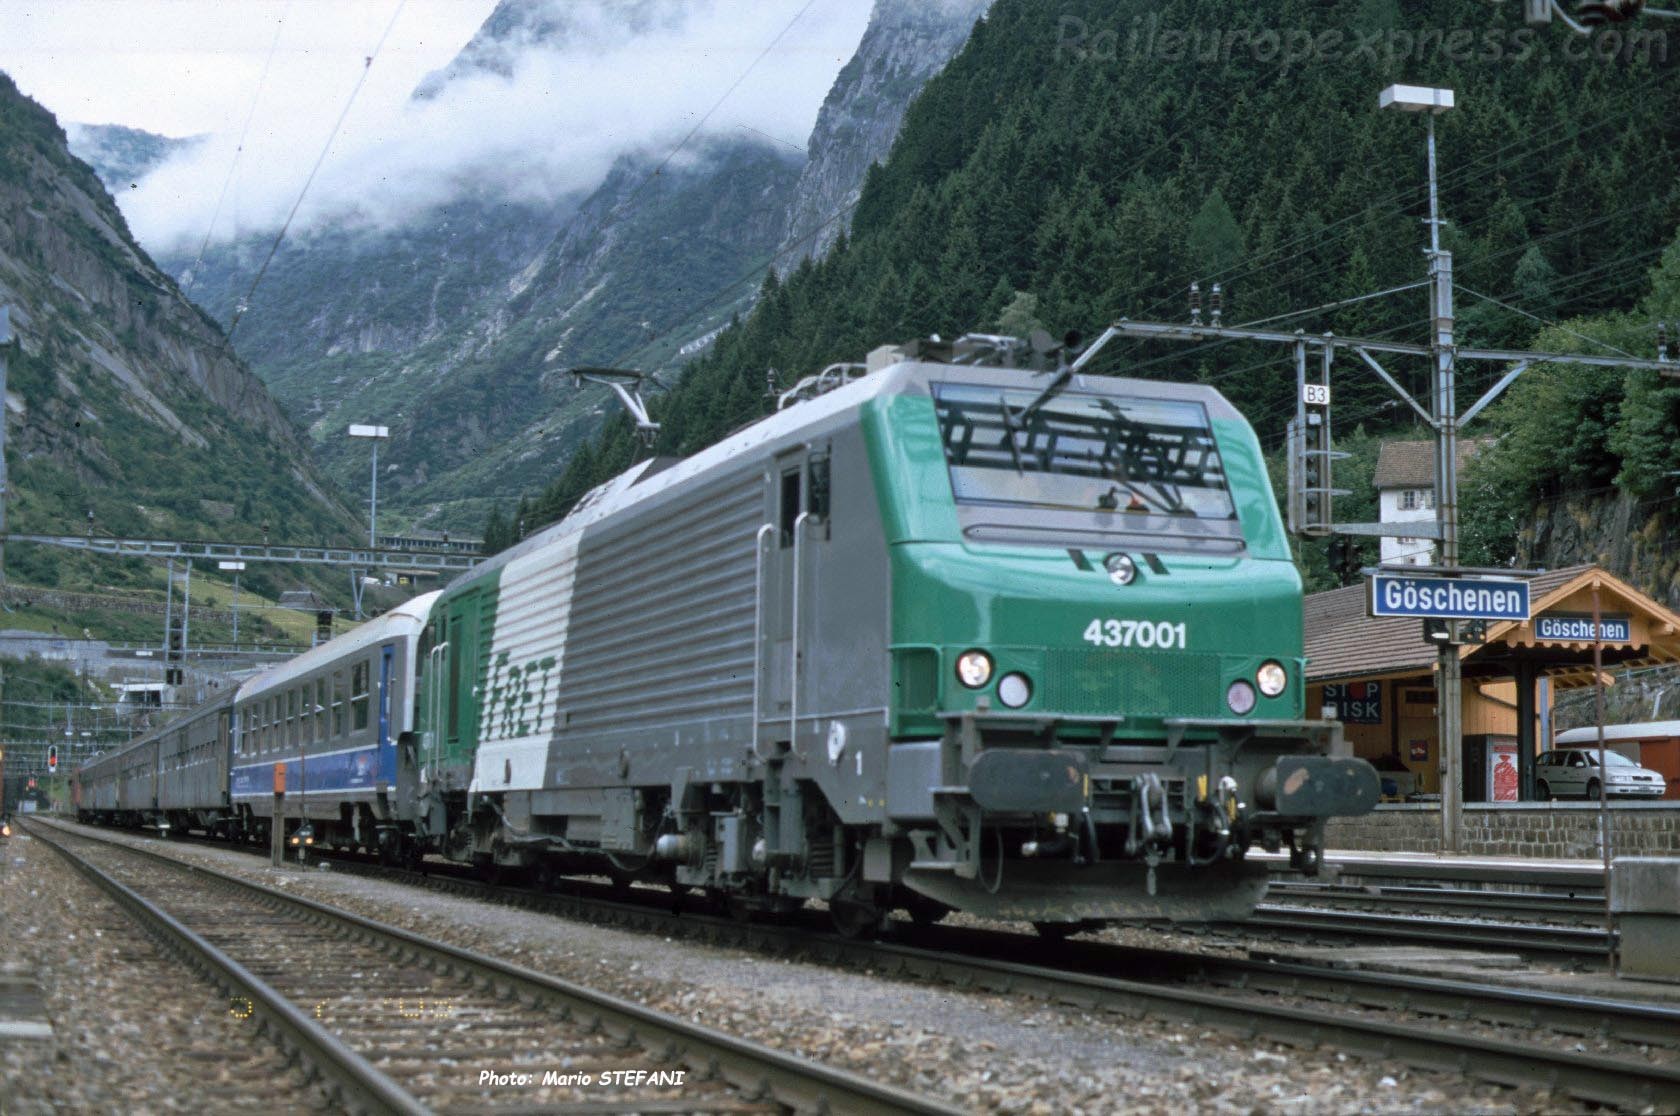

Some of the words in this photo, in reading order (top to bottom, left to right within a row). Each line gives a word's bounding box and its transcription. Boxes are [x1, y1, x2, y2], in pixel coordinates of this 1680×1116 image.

[1307, 386, 1326, 403] B3
[1385, 579, 1521, 613] Göschenen
[1083, 618, 1186, 649] 437001
[1541, 619, 1625, 639] Göschenen
[485, 651, 556, 742] FRET
